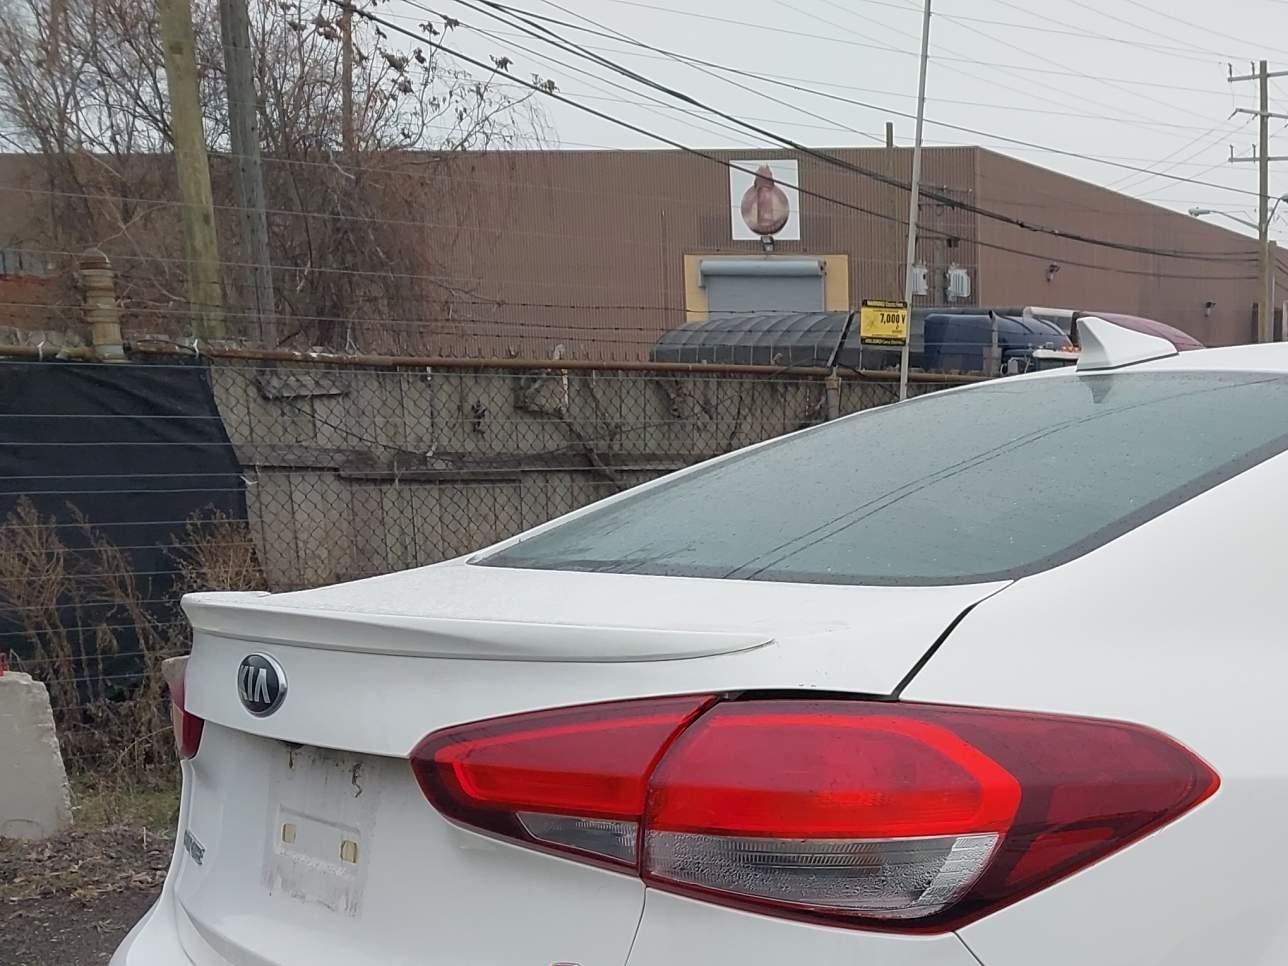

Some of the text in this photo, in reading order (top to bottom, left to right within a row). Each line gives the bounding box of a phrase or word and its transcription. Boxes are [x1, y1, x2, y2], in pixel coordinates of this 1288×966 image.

[880, 312, 906, 325] 7,000 V
[239, 665, 271, 704] KIA
